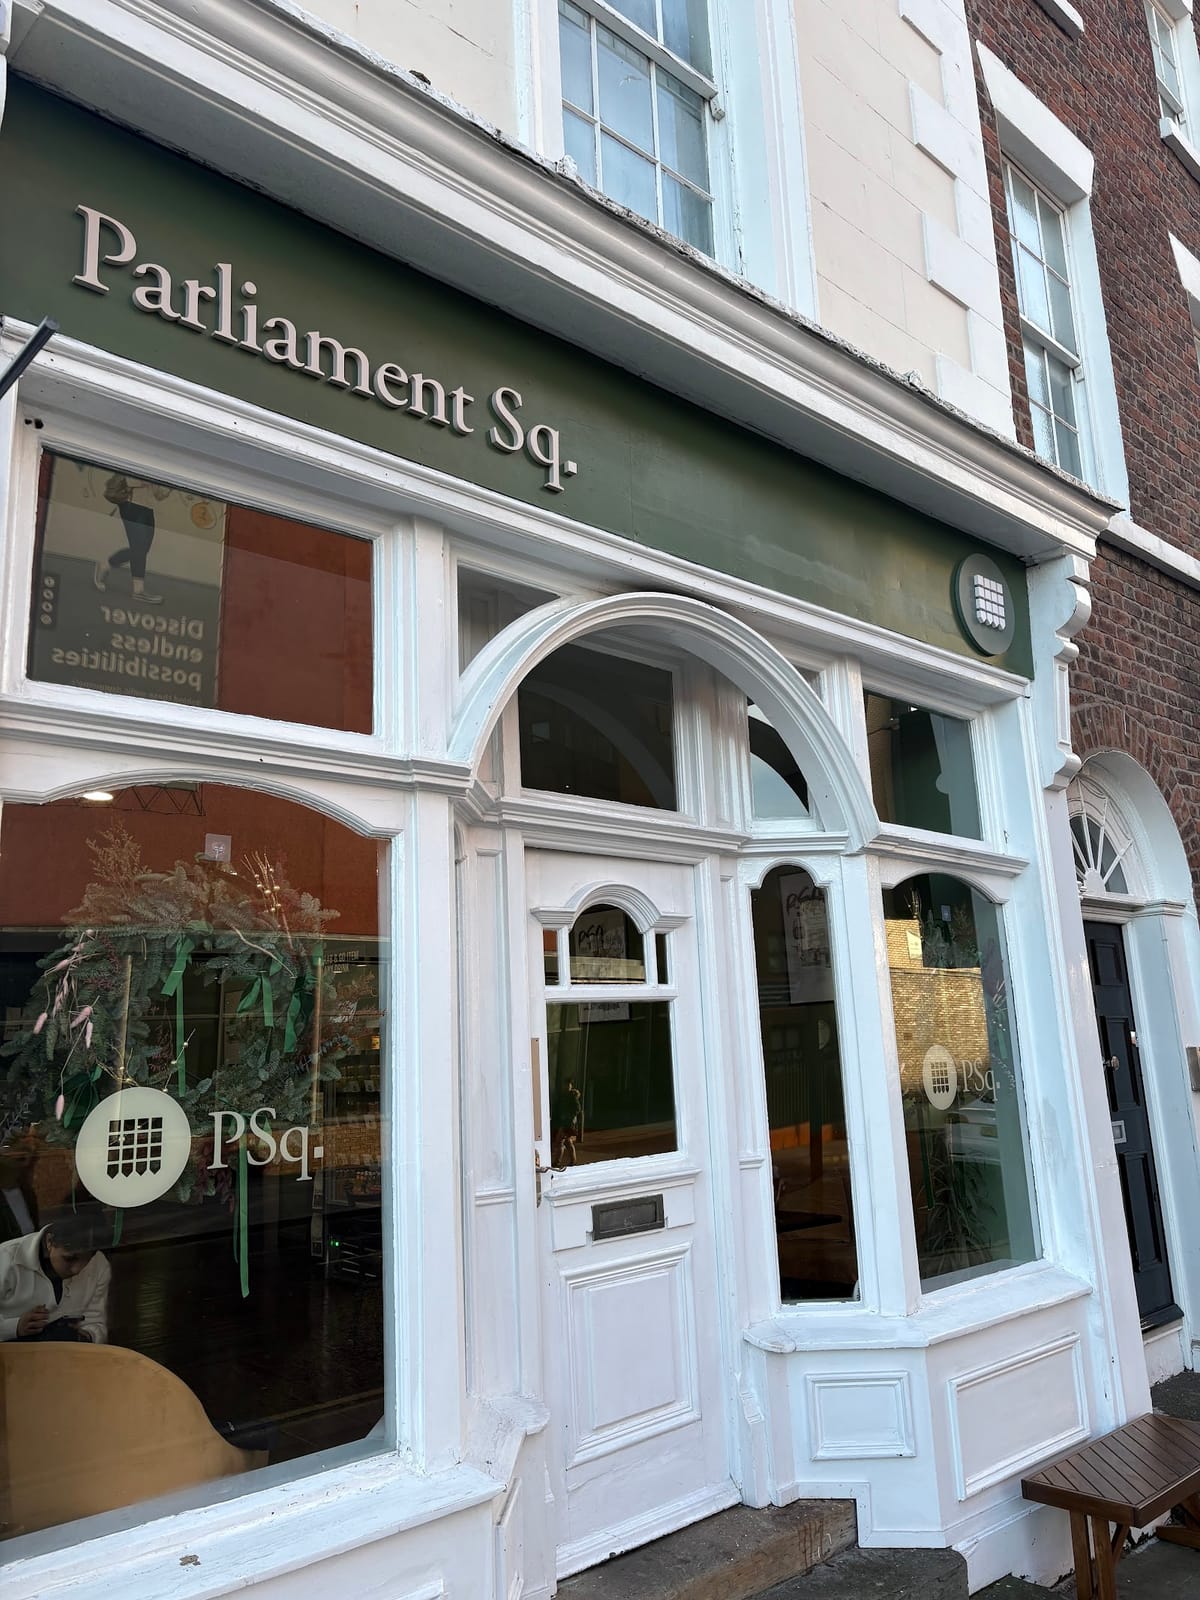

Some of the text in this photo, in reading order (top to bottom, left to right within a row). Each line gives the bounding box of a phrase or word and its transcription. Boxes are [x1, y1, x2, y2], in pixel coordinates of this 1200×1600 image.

[72, 204, 578, 493] Parliament Sq.
[961, 1057, 1001, 1102] PSq.
[207, 1107, 324, 1182] PSq.
